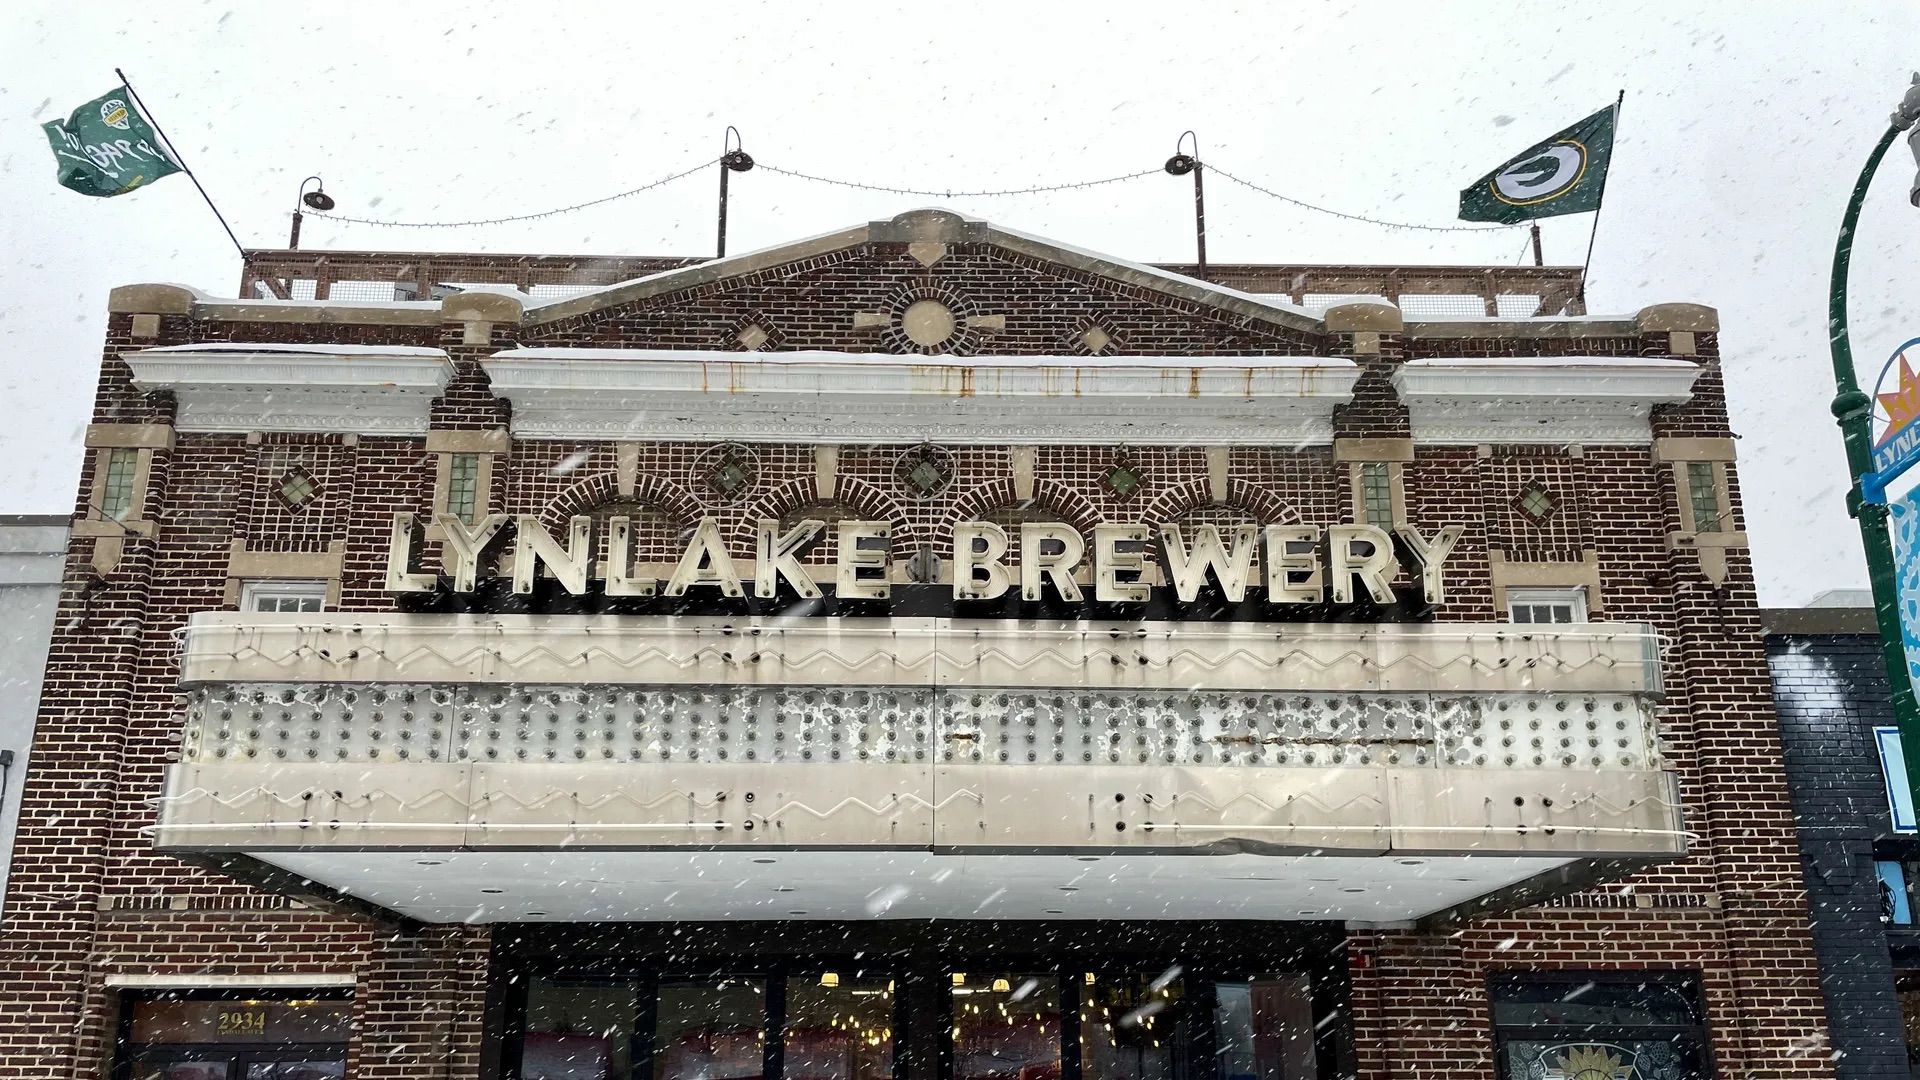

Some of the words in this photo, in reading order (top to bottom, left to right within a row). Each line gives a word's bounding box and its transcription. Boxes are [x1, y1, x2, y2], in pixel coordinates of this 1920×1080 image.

[385, 512, 892, 599] LYNLAKE
[952, 521, 1465, 605] BREWERY
[217, 1011, 265, 1030] 2934
